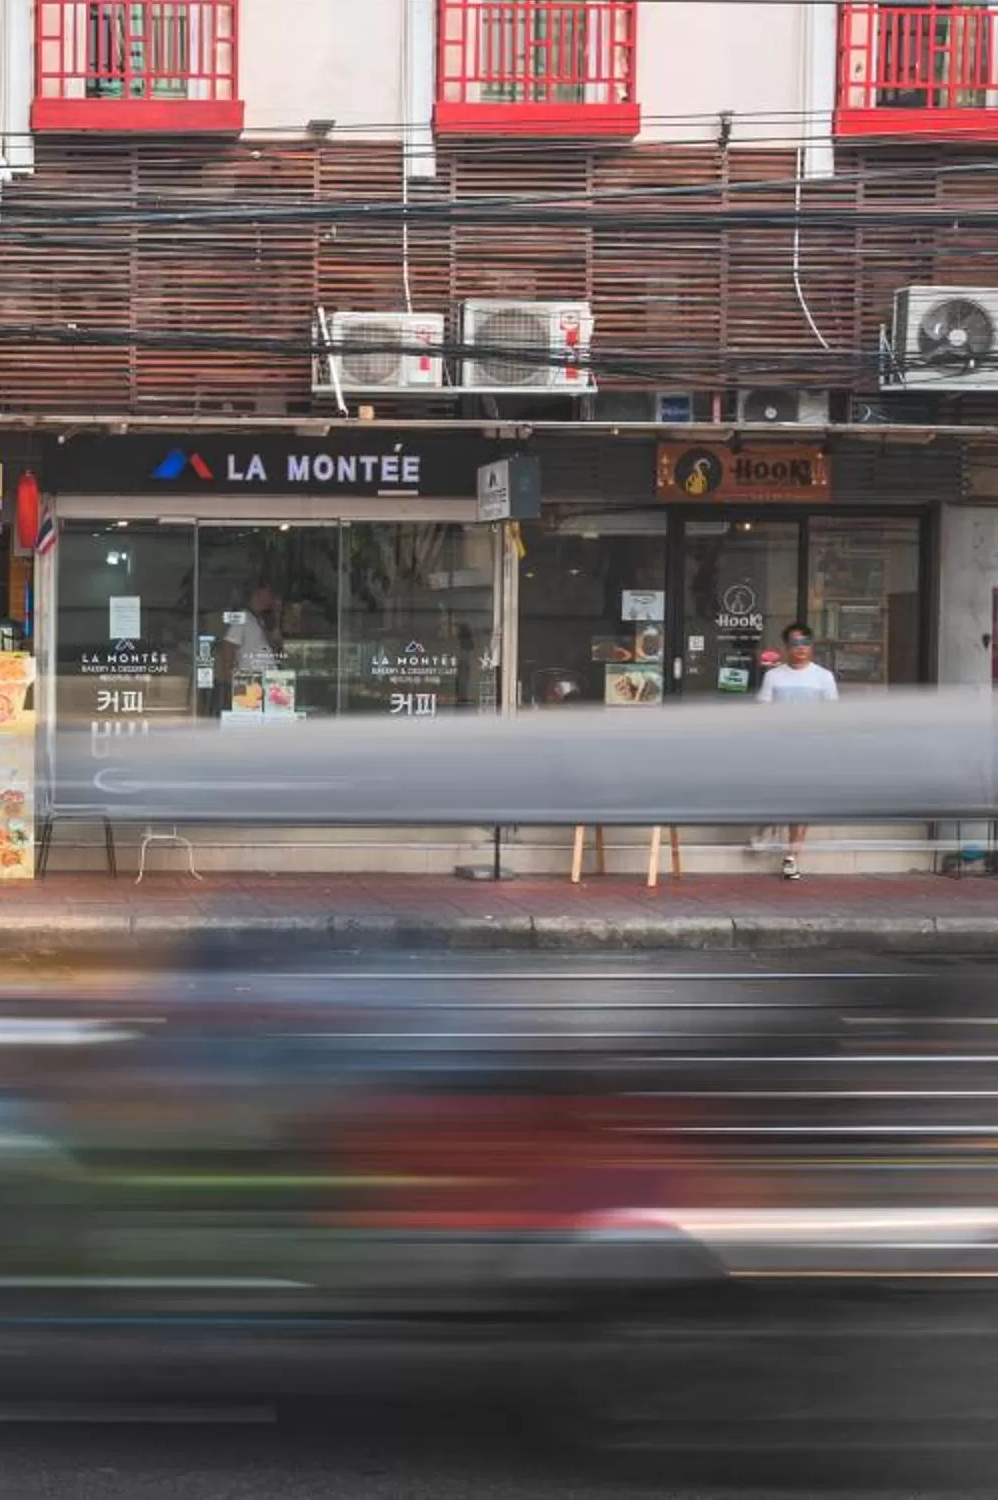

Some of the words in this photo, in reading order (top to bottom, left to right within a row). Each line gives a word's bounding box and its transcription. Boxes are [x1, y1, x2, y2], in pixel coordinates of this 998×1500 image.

[227, 453, 266, 481] LA
[287, 443, 420, 482] MONTÉE
[82, 653, 99, 663] LA
[371, 655, 389, 665] LA
[96, 690, 143, 713] 커피
[389, 693, 437, 716] 커피
